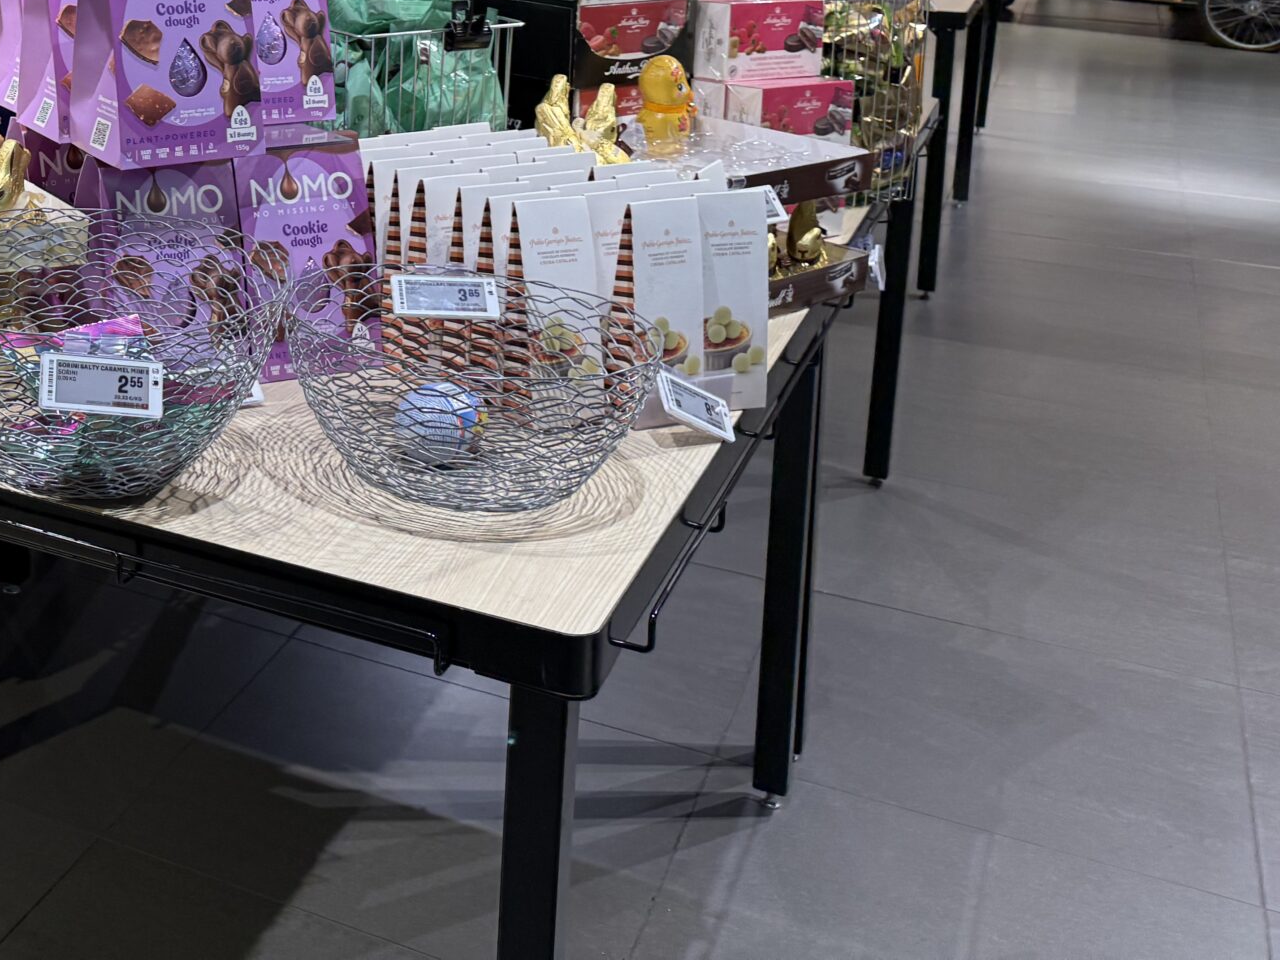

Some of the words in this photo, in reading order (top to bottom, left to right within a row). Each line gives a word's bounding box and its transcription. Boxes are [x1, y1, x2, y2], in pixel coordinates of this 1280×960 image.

[156, 0, 206, 16] Cookie
[165, 14, 200, 29] dough
[234, 117, 248, 127] Egg
[250, 171, 353, 208] NOMO
[253, 209, 270, 218] NO
[276, 204, 326, 217] MISSING
[332, 200, 356, 210] OUT
[282, 220, 329, 237] Cookie
[291, 234, 324, 248] dough
[81, 363, 99, 371] SALTY
[100, 365, 129, 373] CARAMEL
